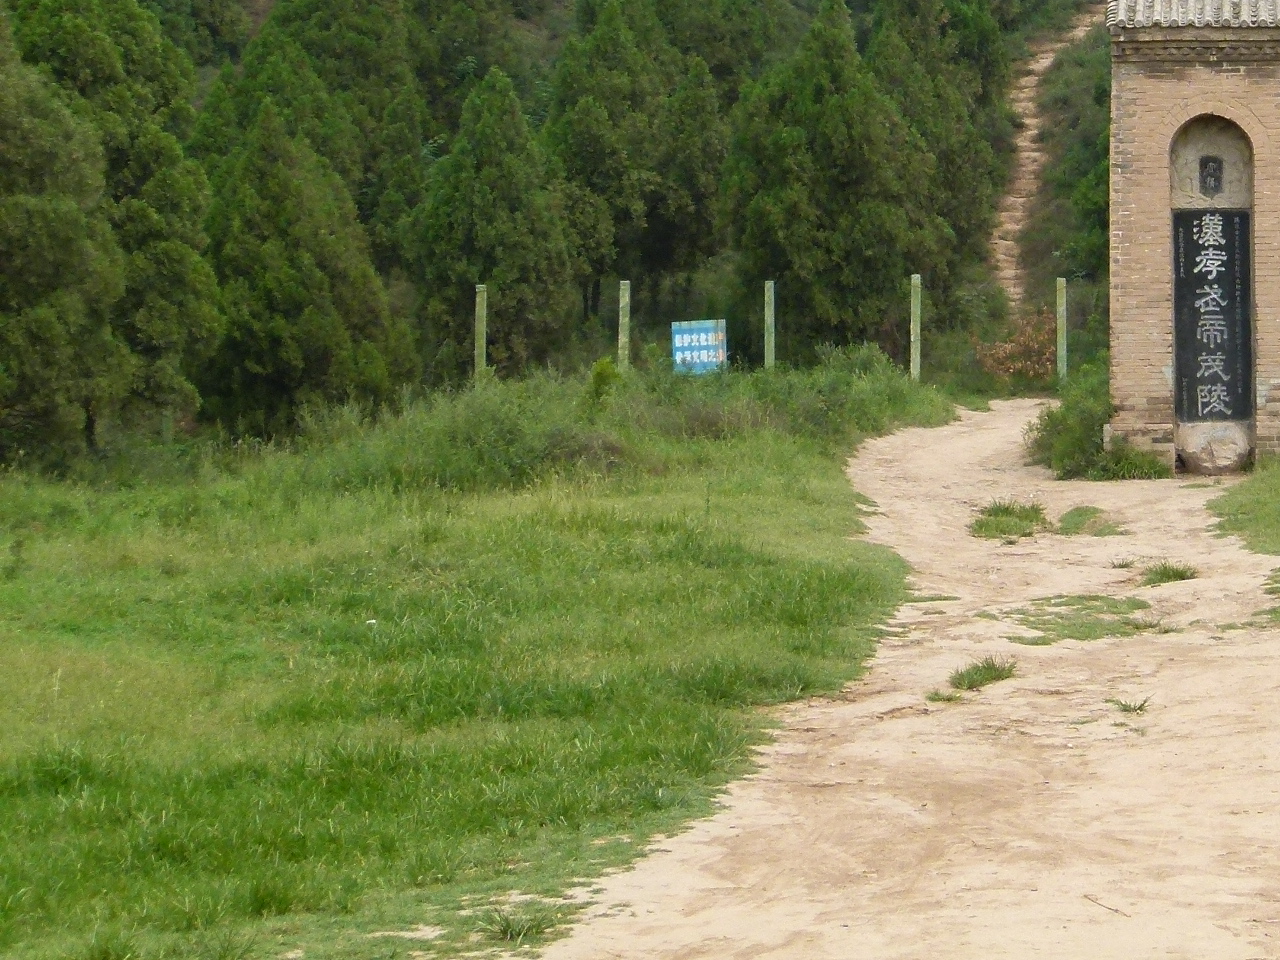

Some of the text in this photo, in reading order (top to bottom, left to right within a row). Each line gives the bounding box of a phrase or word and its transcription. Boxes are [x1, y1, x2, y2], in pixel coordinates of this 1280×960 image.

[1193, 213, 1232, 417] 漢孝武帝茂陵
